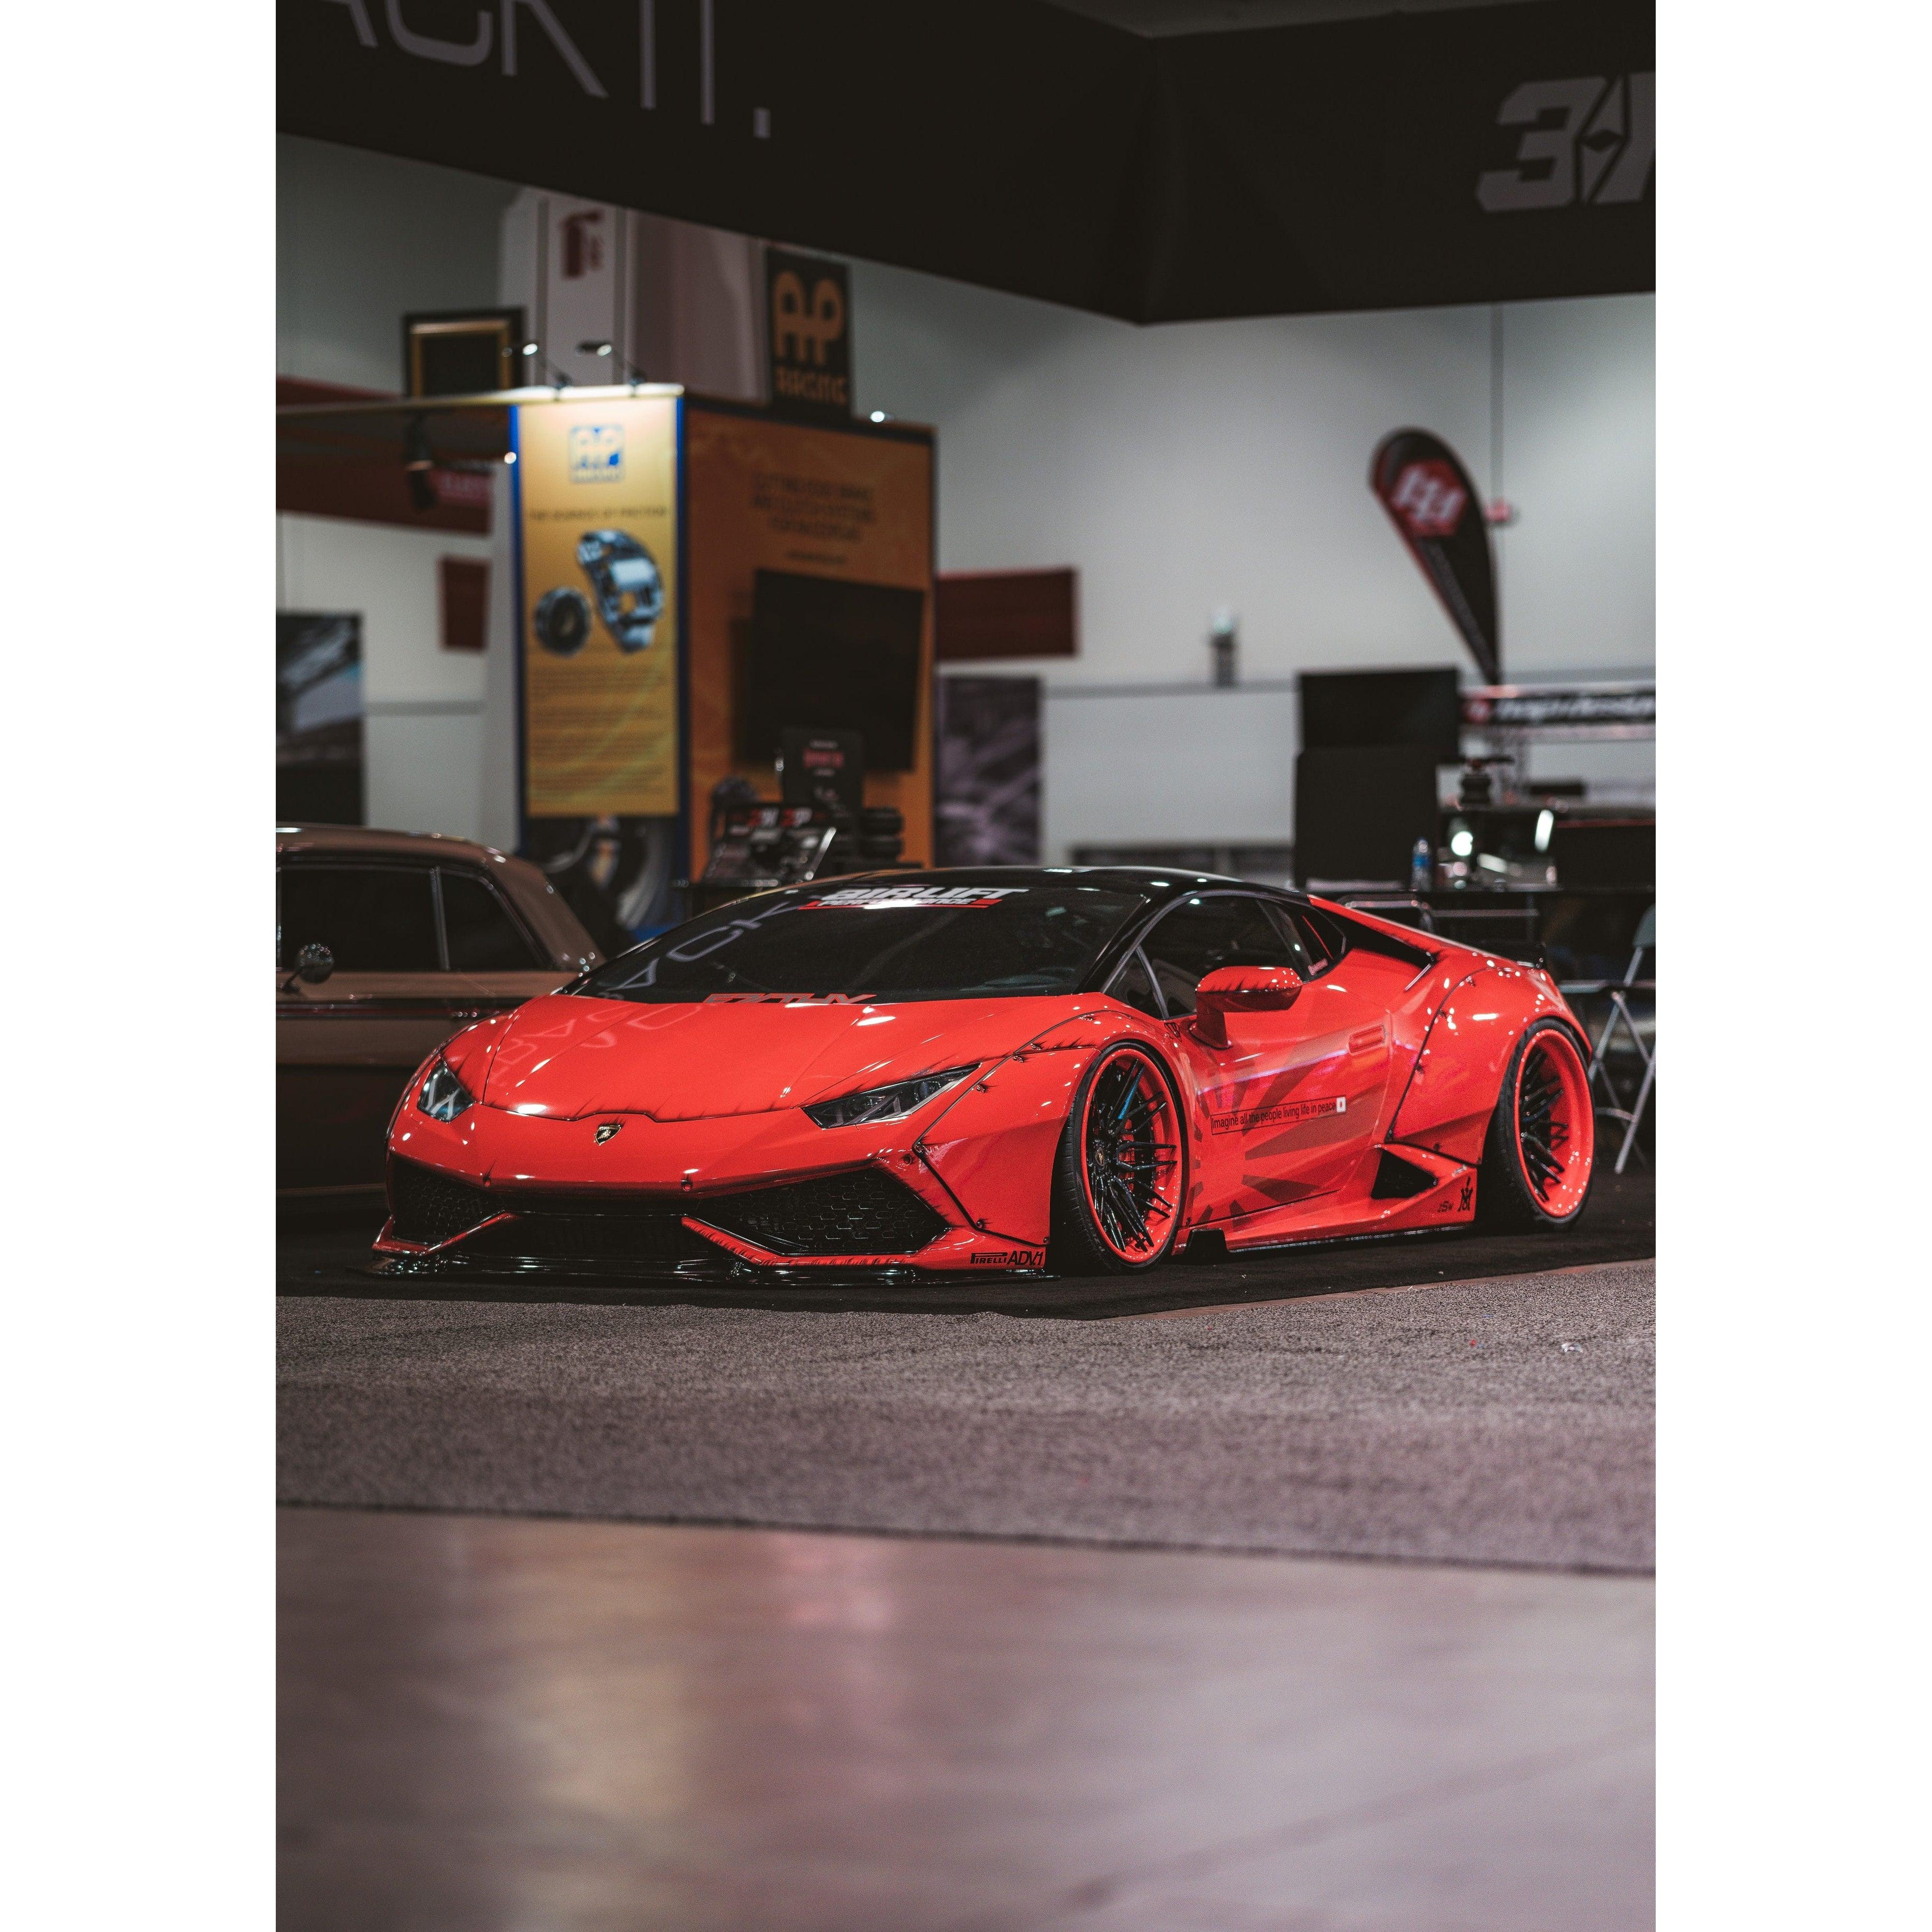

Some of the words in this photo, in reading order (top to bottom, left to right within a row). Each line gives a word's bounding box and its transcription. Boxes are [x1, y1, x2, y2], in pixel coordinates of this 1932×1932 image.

[1212, 1114, 1238, 1130] Imagine
[1250, 1112, 1261, 1123] the
[1261, 1108, 1282, 1124] people
[1283, 1106, 1300, 1119] living
[1300, 1103, 1310, 1115] life
[1318, 1102, 1336, 1115] peace
[970, 1252, 1008, 1264] PIRELLI
